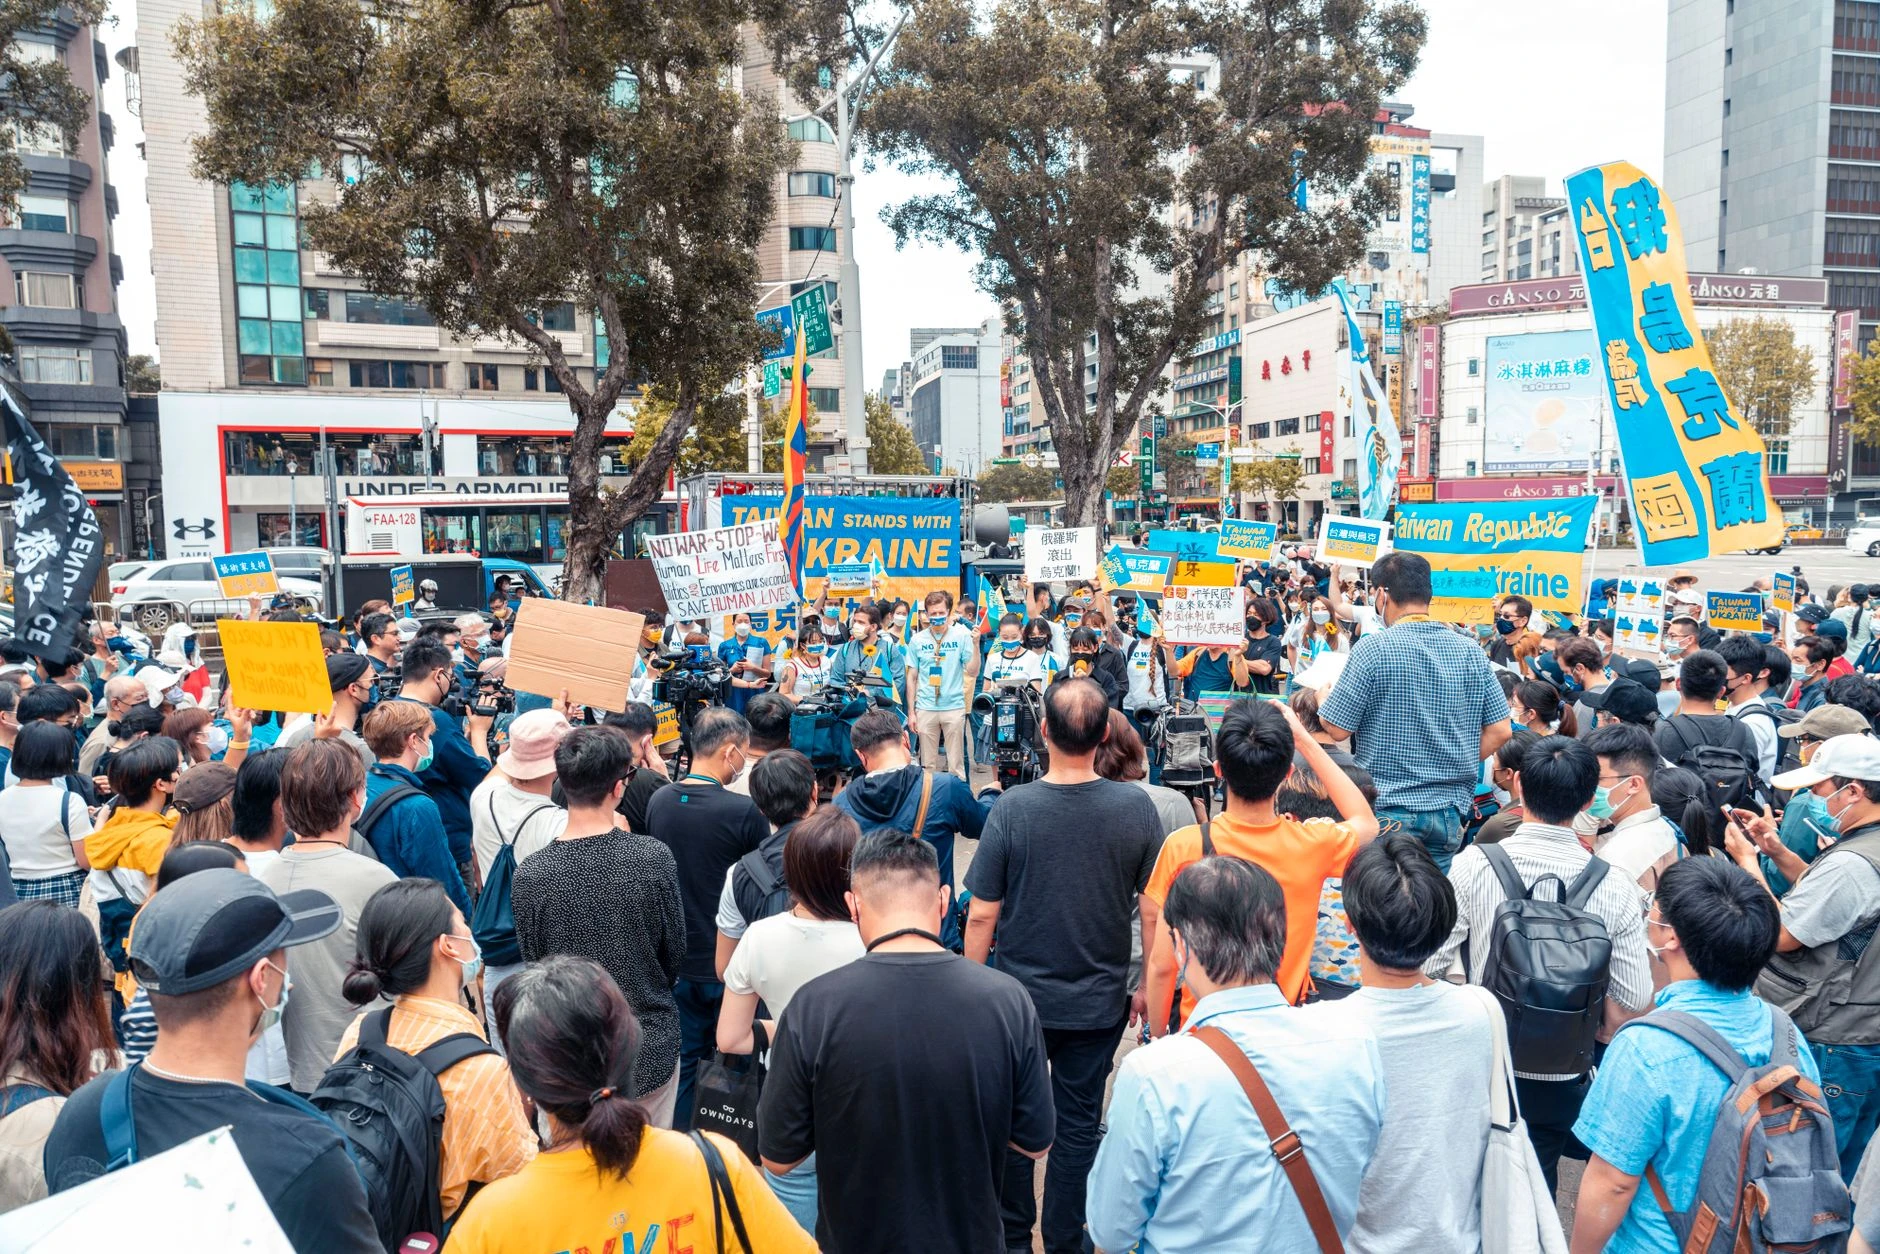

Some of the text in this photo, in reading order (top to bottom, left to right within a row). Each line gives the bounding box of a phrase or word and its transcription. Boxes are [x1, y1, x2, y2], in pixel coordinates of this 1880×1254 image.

[1487, 286, 1561, 307] GANSO
[1749, 283, 1779, 301] 元祖
[1424, 342, 1434, 370] 元祖
[1503, 484, 1547, 498] GANSO
[373, 513, 416, 525] FAA-128
[842, 515, 908, 528] STANDS
[912, 515, 952, 529] WITH
[1224, 524, 1268, 536] TAIWAN
[714, 525, 755, 551] STOP
[1041, 531, 1079, 545] 俄羅斯
[1220, 536, 1270, 550] UKRAINE
[765, 543, 785, 564] Firs
[805, 538, 952, 569] KRAINE
[1047, 549, 1073, 562] 滾出
[1125, 557, 1161, 572] 烏克蘭
[677, 586, 791, 618] SAVE HUMAN LIVES
[1710, 596, 1752, 607] TAIWAN
[1709, 609, 1759, 621] UKRAINE
[921, 643, 934, 651] NO
[699, 1106, 755, 1130] OWNDAYS
